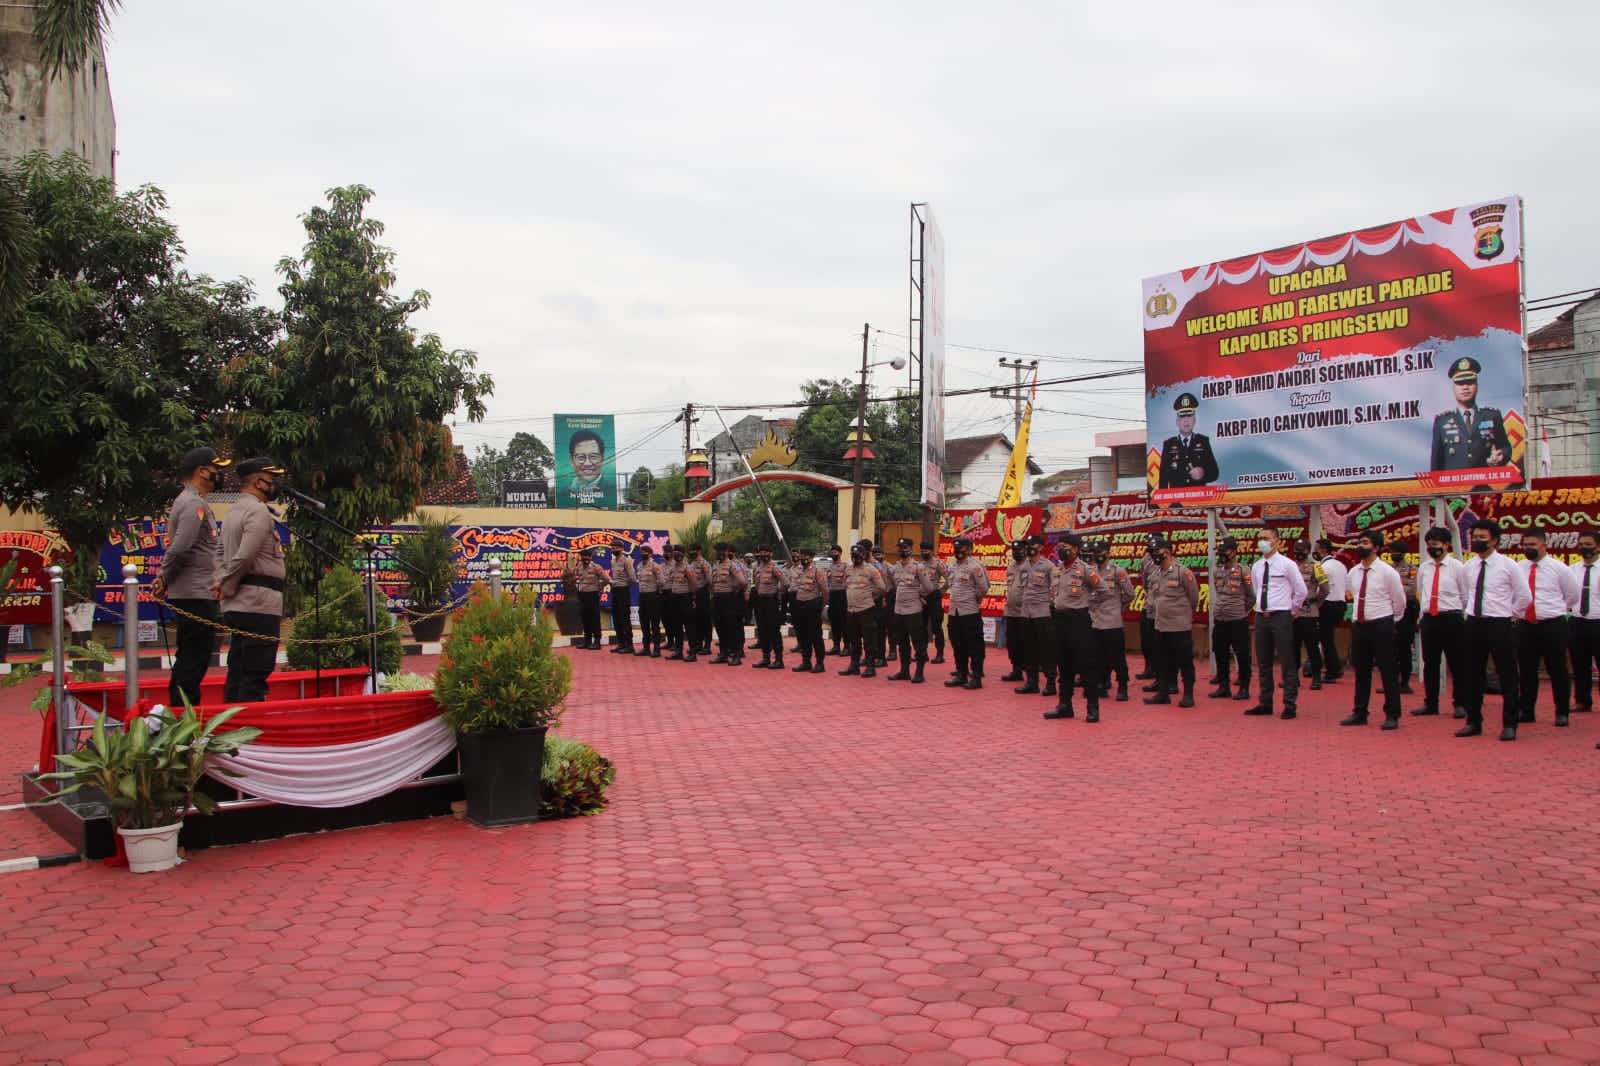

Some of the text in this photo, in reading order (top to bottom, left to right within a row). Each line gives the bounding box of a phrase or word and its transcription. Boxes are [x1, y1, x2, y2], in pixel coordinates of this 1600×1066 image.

[1269, 263, 1347, 296] UPACARA
[1186, 270, 1453, 337] WELCOME AND FAREWEL PARADE
[1219, 307, 1409, 357] KAPOLRES PRINGSEWU
[1296, 349, 1321, 364] Dari
[1202, 350, 1434, 399] AKBP HAMID ANDRI SOEMANTRI, S.IK
[1290, 389, 1331, 409] Kepada
[1216, 420, 1247, 438] AKBP
[1250, 416, 1271, 435] RIO
[1274, 408, 1352, 432] CAHYOWIDI,
[1238, 464, 1395, 484] PRINGSEWU, NOVEMBER 2021
[506, 492, 547, 502] MUSTIKA
[570, 534, 614, 550] SUKSES
